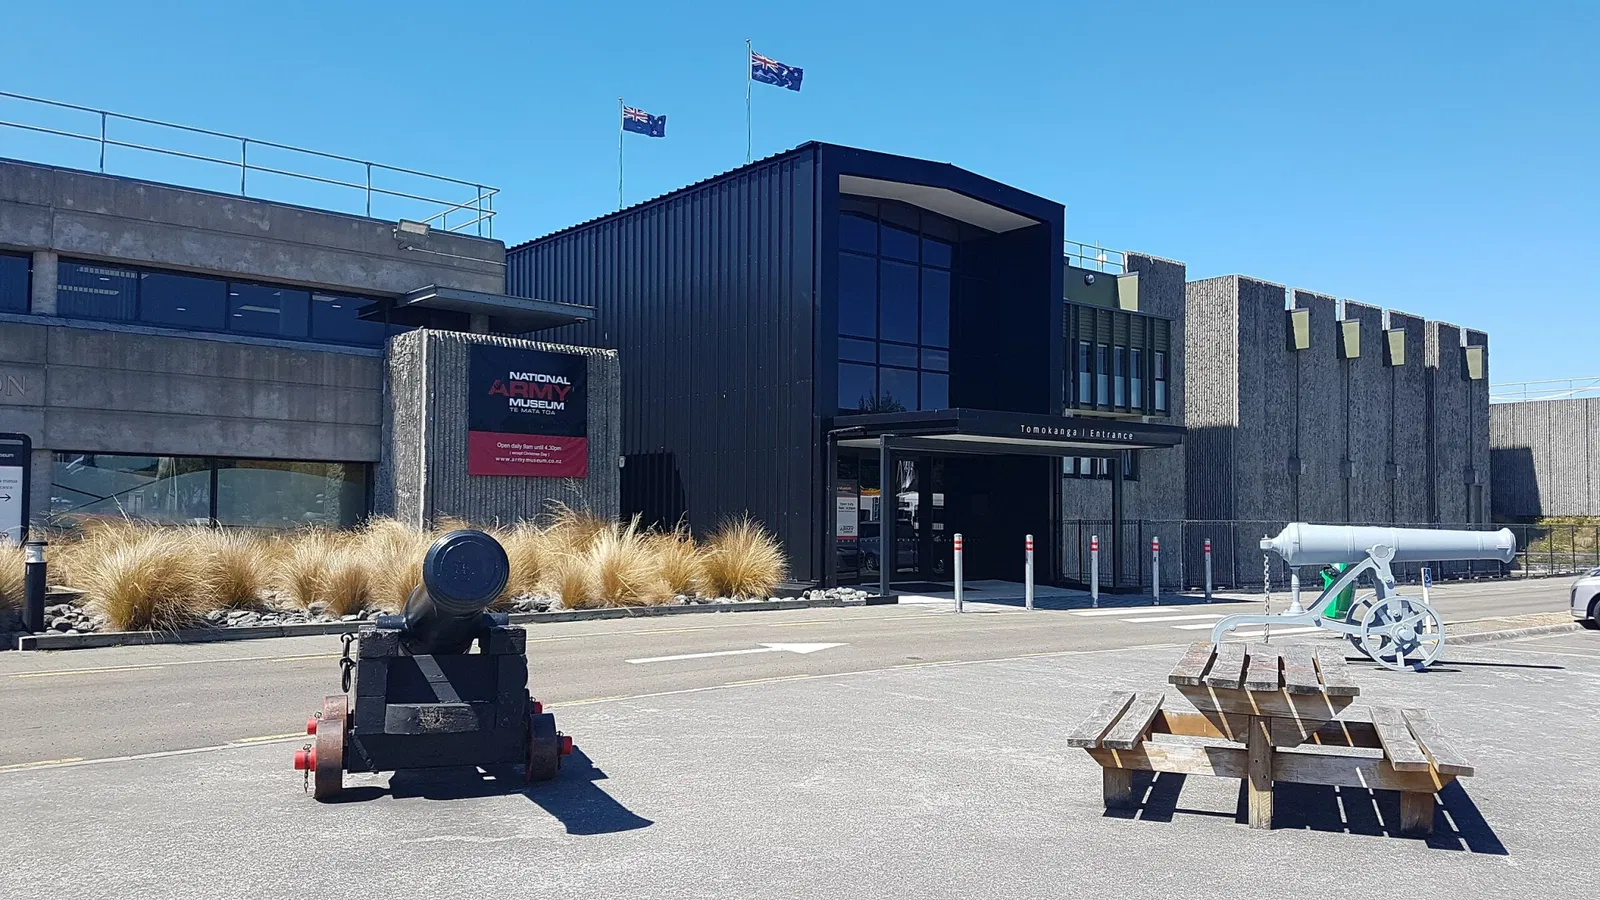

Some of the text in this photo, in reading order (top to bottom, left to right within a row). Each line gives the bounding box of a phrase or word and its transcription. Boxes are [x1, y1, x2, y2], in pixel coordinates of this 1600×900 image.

[509, 371, 571, 385] NATIONAL
[0, 375, 27, 397] N
[488, 379, 572, 402] ARMY
[509, 397, 565, 411] MUSEUM
[1020, 424, 1077, 438] Tomokanga
[1090, 429, 1134, 440] Entrance
[496, 441, 511, 449] Open
